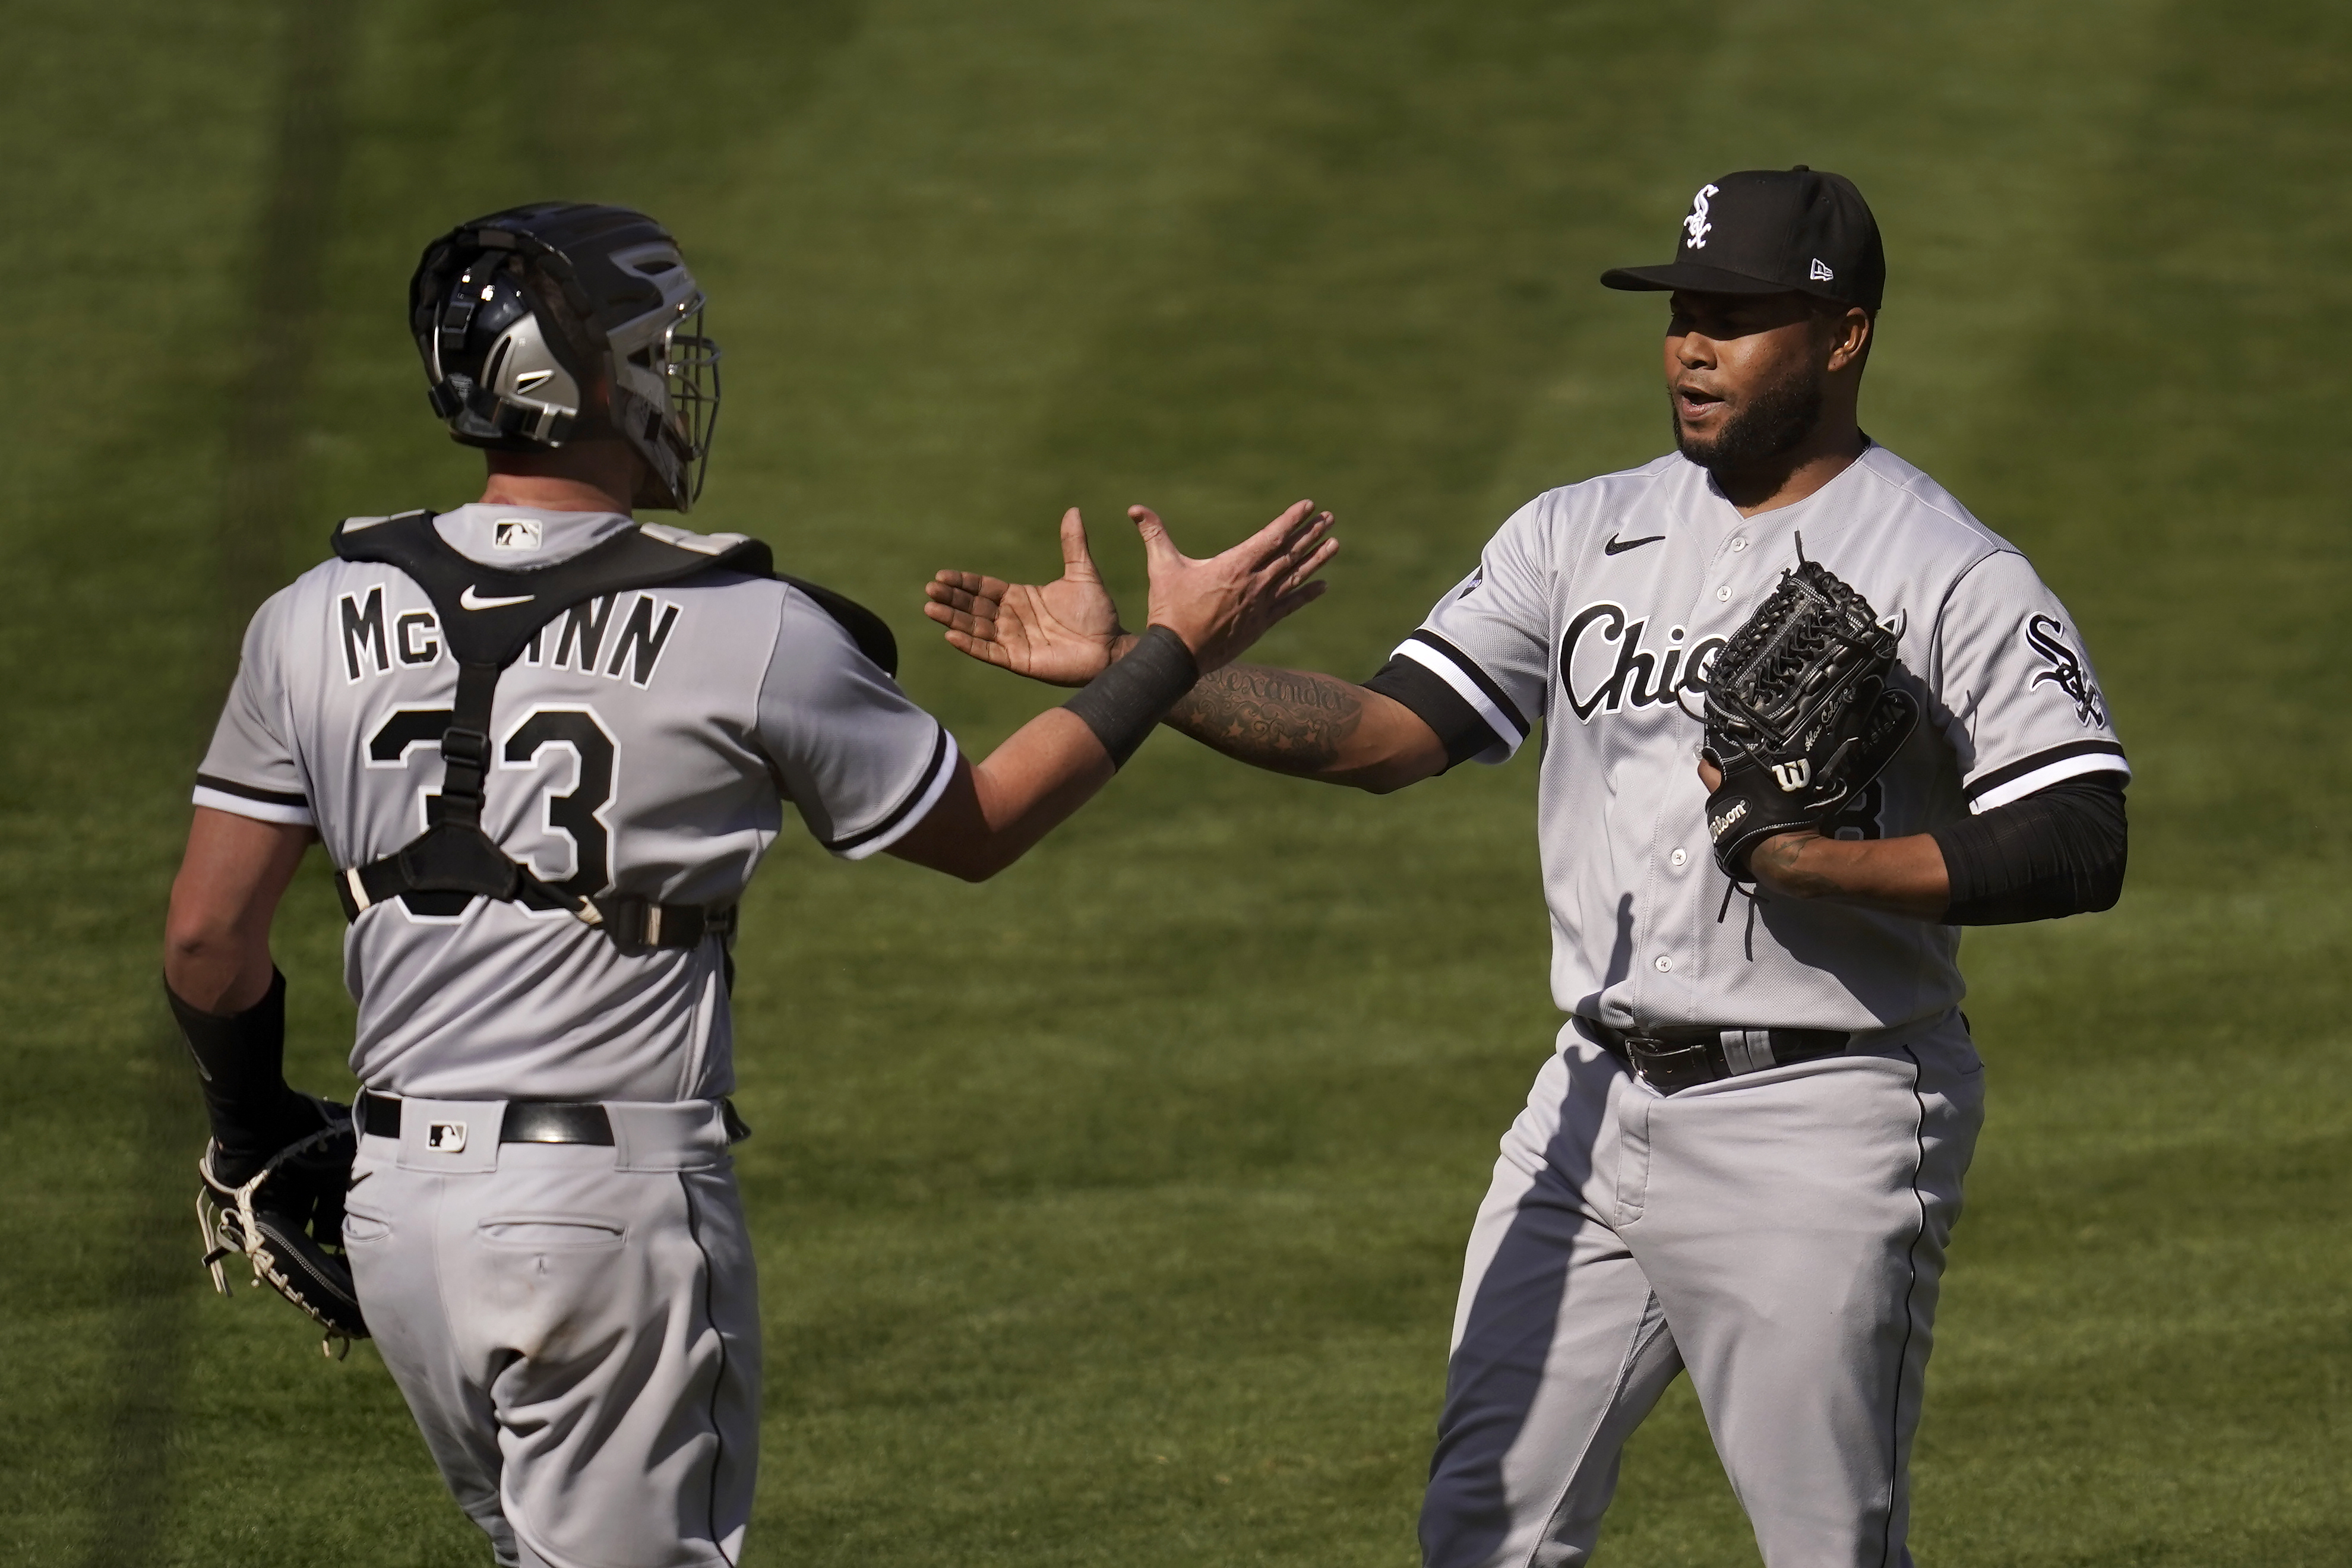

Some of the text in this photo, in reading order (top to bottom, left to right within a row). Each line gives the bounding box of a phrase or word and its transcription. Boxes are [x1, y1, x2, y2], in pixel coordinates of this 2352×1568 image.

[337, 582, 684, 691] McNN
[1205, 668, 1346, 710] lexander
[1556, 599, 1735, 726] Chic
[2025, 611, 2107, 730] Sox
[1772, 757, 1811, 792] W
